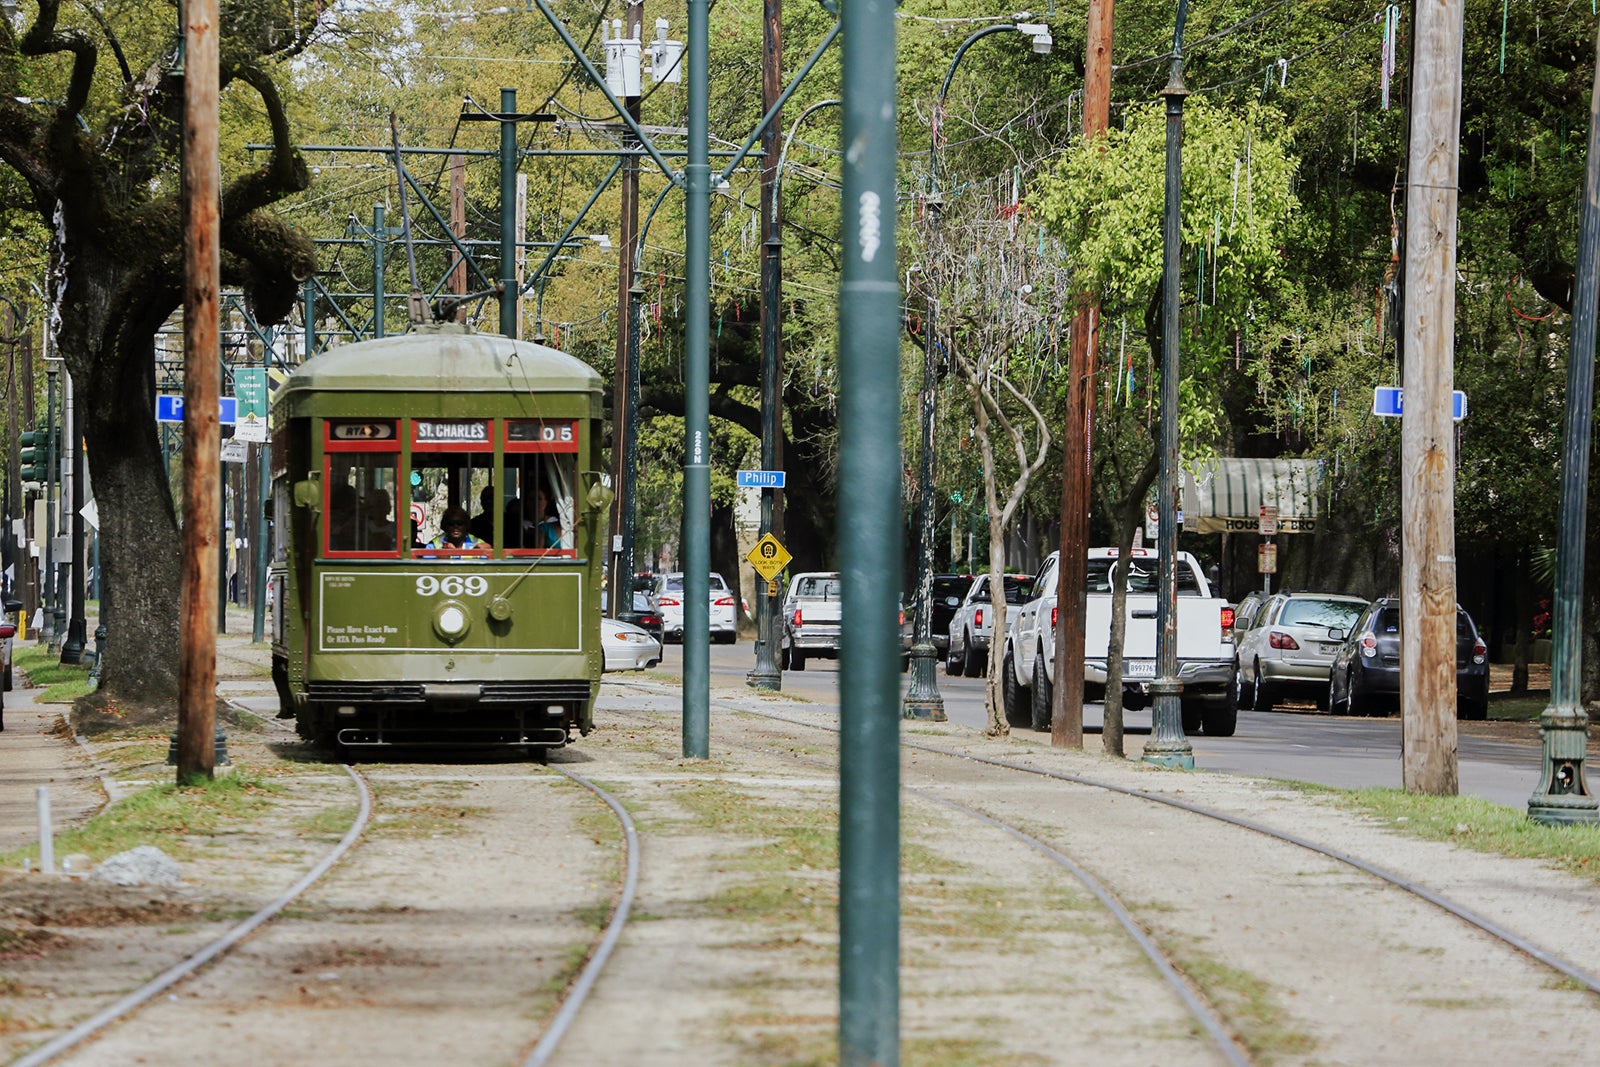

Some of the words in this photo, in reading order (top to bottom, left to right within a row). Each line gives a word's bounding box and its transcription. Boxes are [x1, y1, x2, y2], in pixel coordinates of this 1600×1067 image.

[345, 427, 366, 436] RTA
[419, 423, 434, 437] ST.
[436, 424, 485, 439] CHARLES
[745, 472, 777, 485] Philip
[1226, 520, 1259, 530] HOUS
[415, 575, 489, 597] 969
[326, 625, 346, 634] Please
[346, 625, 362, 634] Have
[363, 625, 383, 634] Exact
[383, 625, 398, 634] Fare
[326, 635, 335, 643] Or
[336, 635, 350, 643] RTA
[351, 635, 365, 643] Pass
[366, 635, 386, 644] Ready
